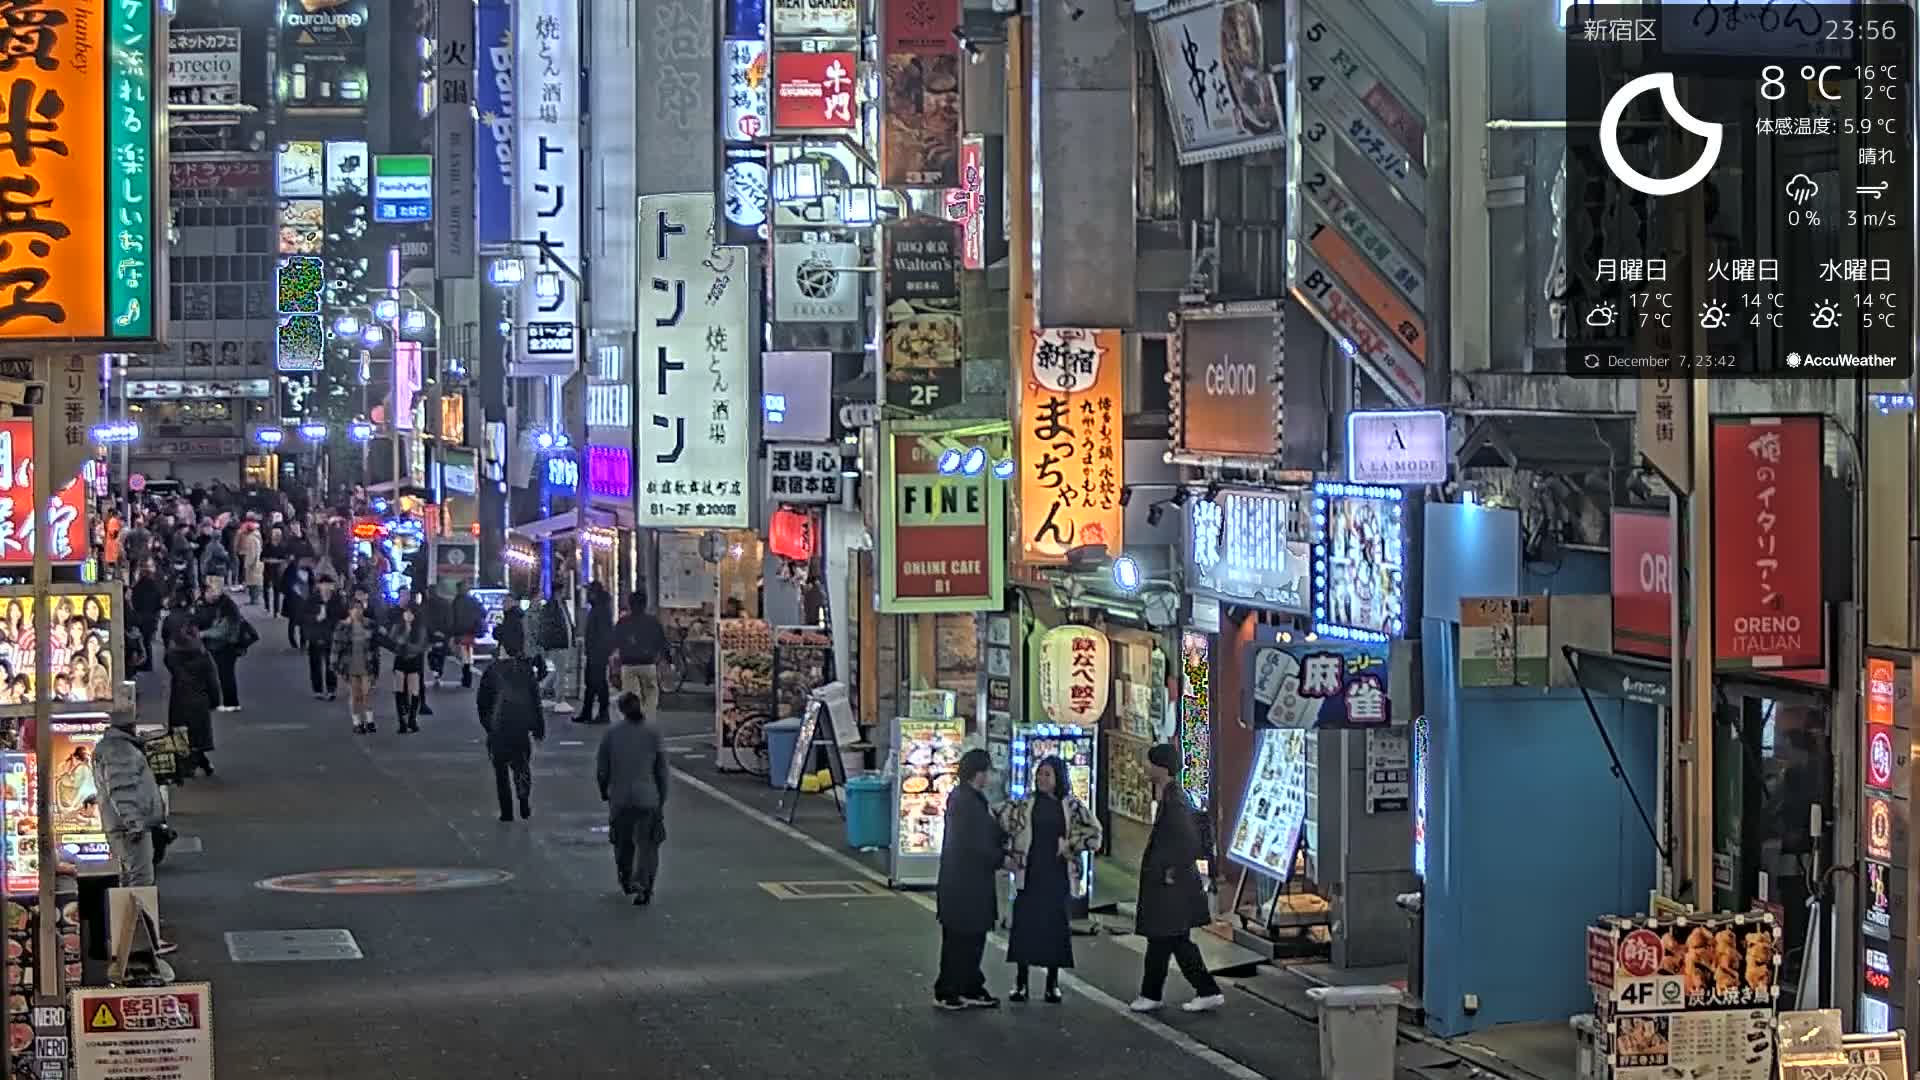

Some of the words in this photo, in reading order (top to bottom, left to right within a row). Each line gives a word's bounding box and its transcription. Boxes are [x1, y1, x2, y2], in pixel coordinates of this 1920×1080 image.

[1306, 22, 1329, 43] 5
[823, 59, 852, 121] 牛門
[1307, 75, 1325, 92] 4
[1307, 122, 1327, 143] 3
[379, 181, 428, 193] FamilyMart
[1305, 173, 1326, 193] 2
[894, 257, 951, 271] Walton's
[653, 209, 685, 463] トントン
[704, 325, 732, 446] 焼とん酒場
[1205, 356, 1257, 395] celona
[910, 385, 940, 406] 2F
[773, 451, 836, 472] 酒場心
[1033, 396, 1079, 546] まっちゃん
[1394, 461, 1438, 472] MODE
[772, 477, 836, 494] 新宿本店
[904, 486, 980, 513] FINE
[1747, 431, 1784, 605] 俺のイタリアン
[903, 561, 947, 575] ONLINE
[951, 561, 981, 575] CAFE
[935, 579, 950, 593] B1
[1734, 616, 1801, 635] ORENO
[1732, 634, 1801, 652] ITALIAN
[1070, 636, 1097, 714] 鉄なべ餃子
[1301, 652, 1388, 723] 麻雀
[1621, 983, 1654, 1005] 4F
[34, 1007, 66, 1026] NERO
[37, 1038, 68, 1057] NERO
